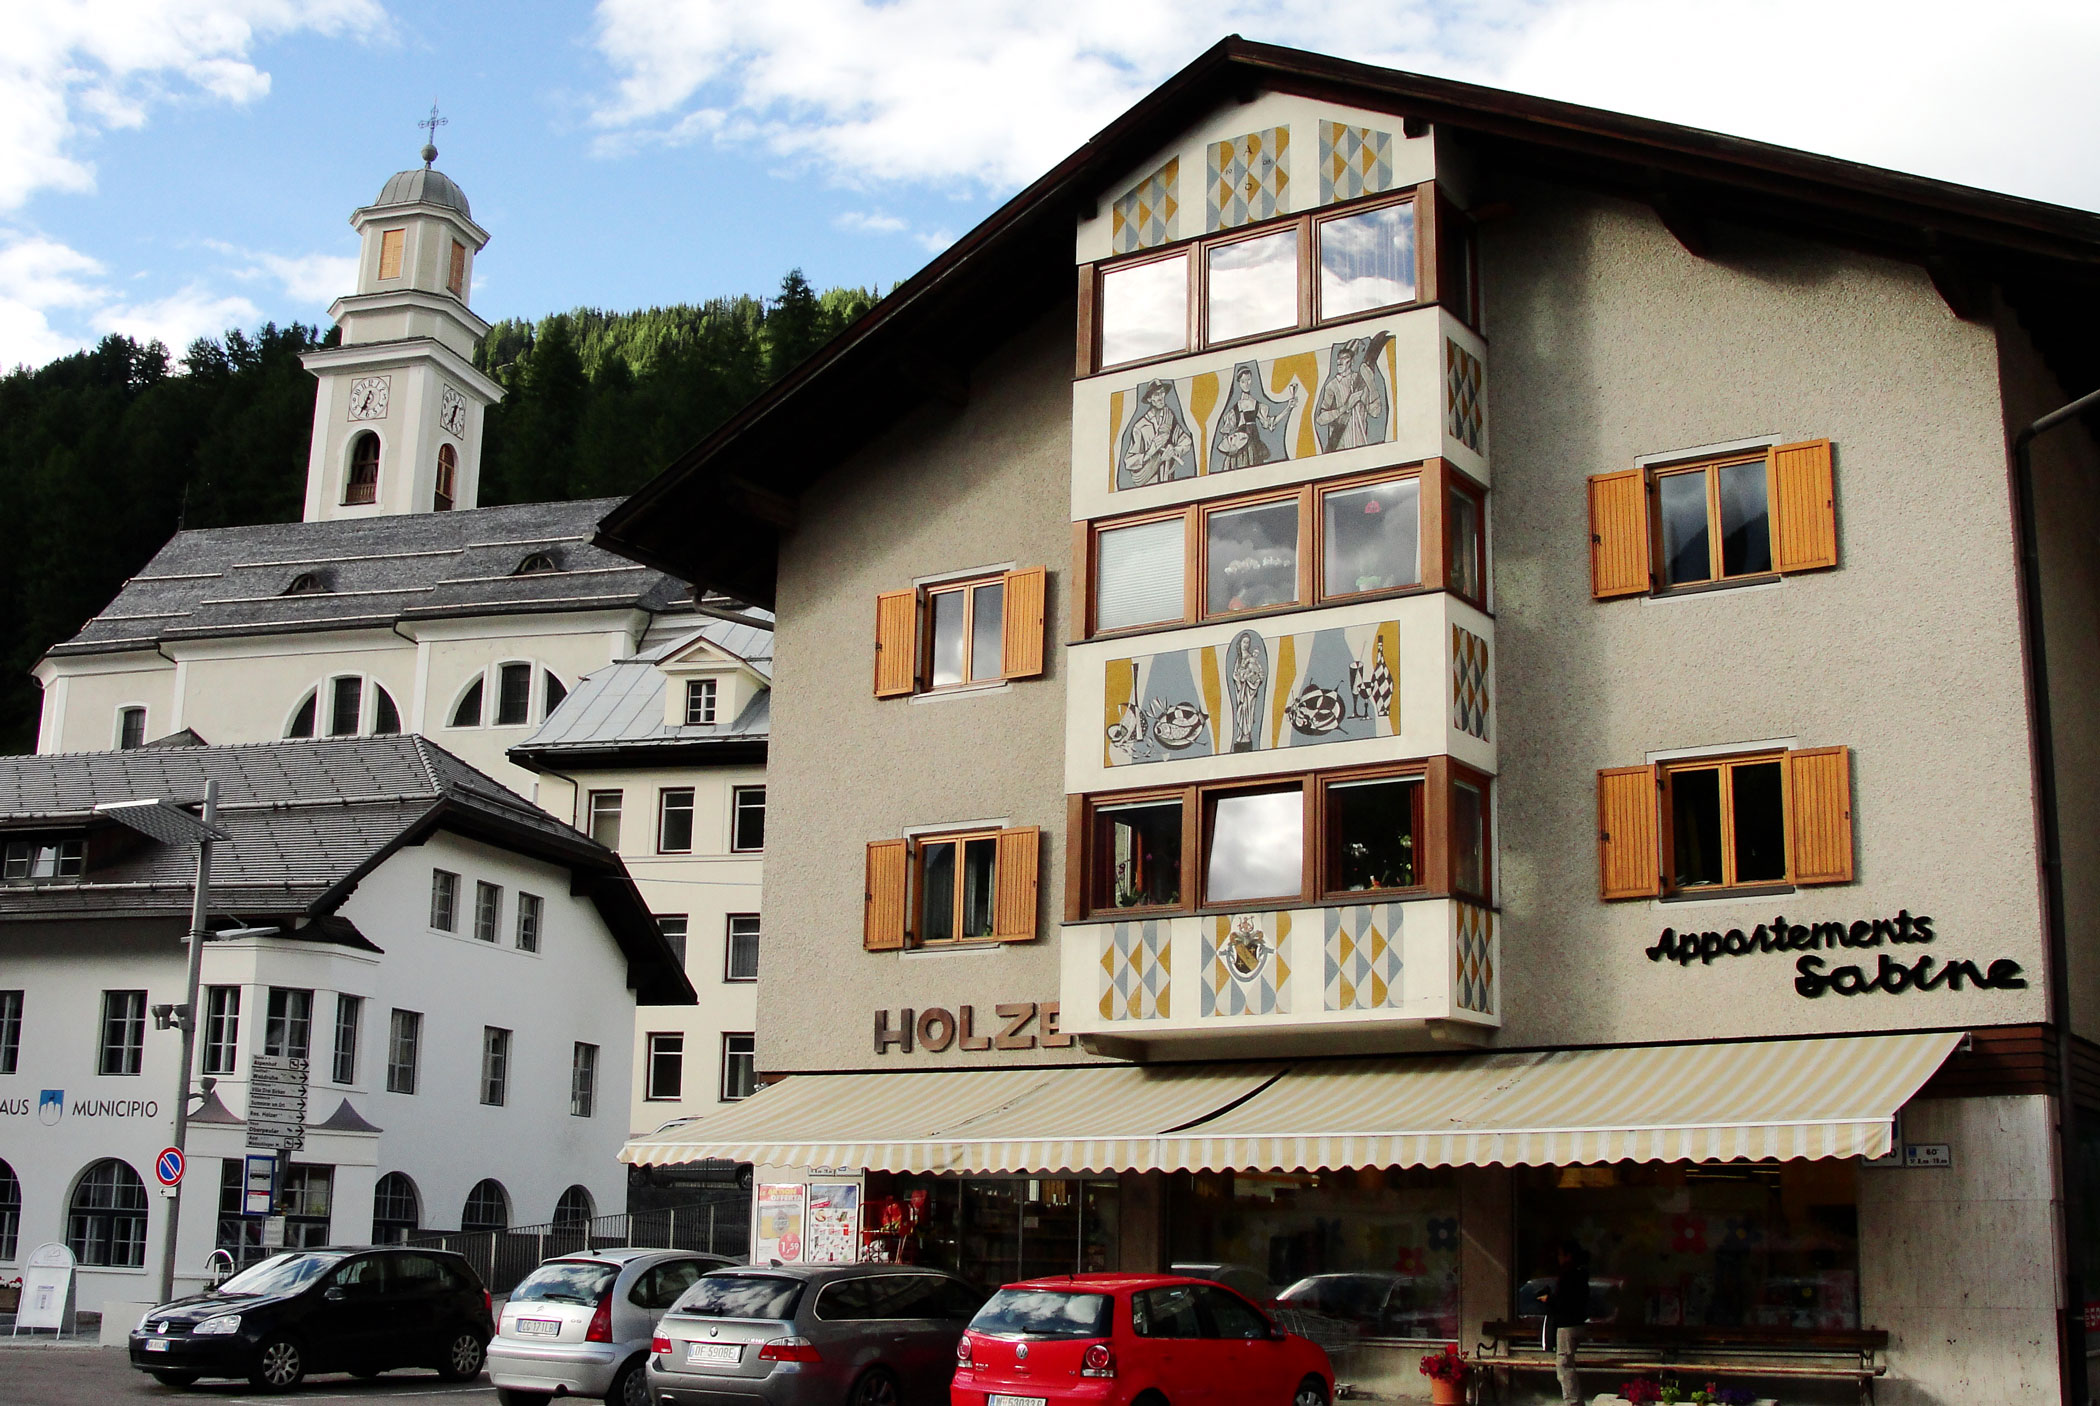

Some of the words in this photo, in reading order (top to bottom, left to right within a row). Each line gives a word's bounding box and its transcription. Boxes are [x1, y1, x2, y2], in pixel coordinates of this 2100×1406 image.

[1646, 909, 1935, 967] Appartements
[1795, 953, 2026, 1000] Sabine
[72, 1099, 159, 1118] MUNICIPIO
[780, 1241, 800, 1254] 1,59
